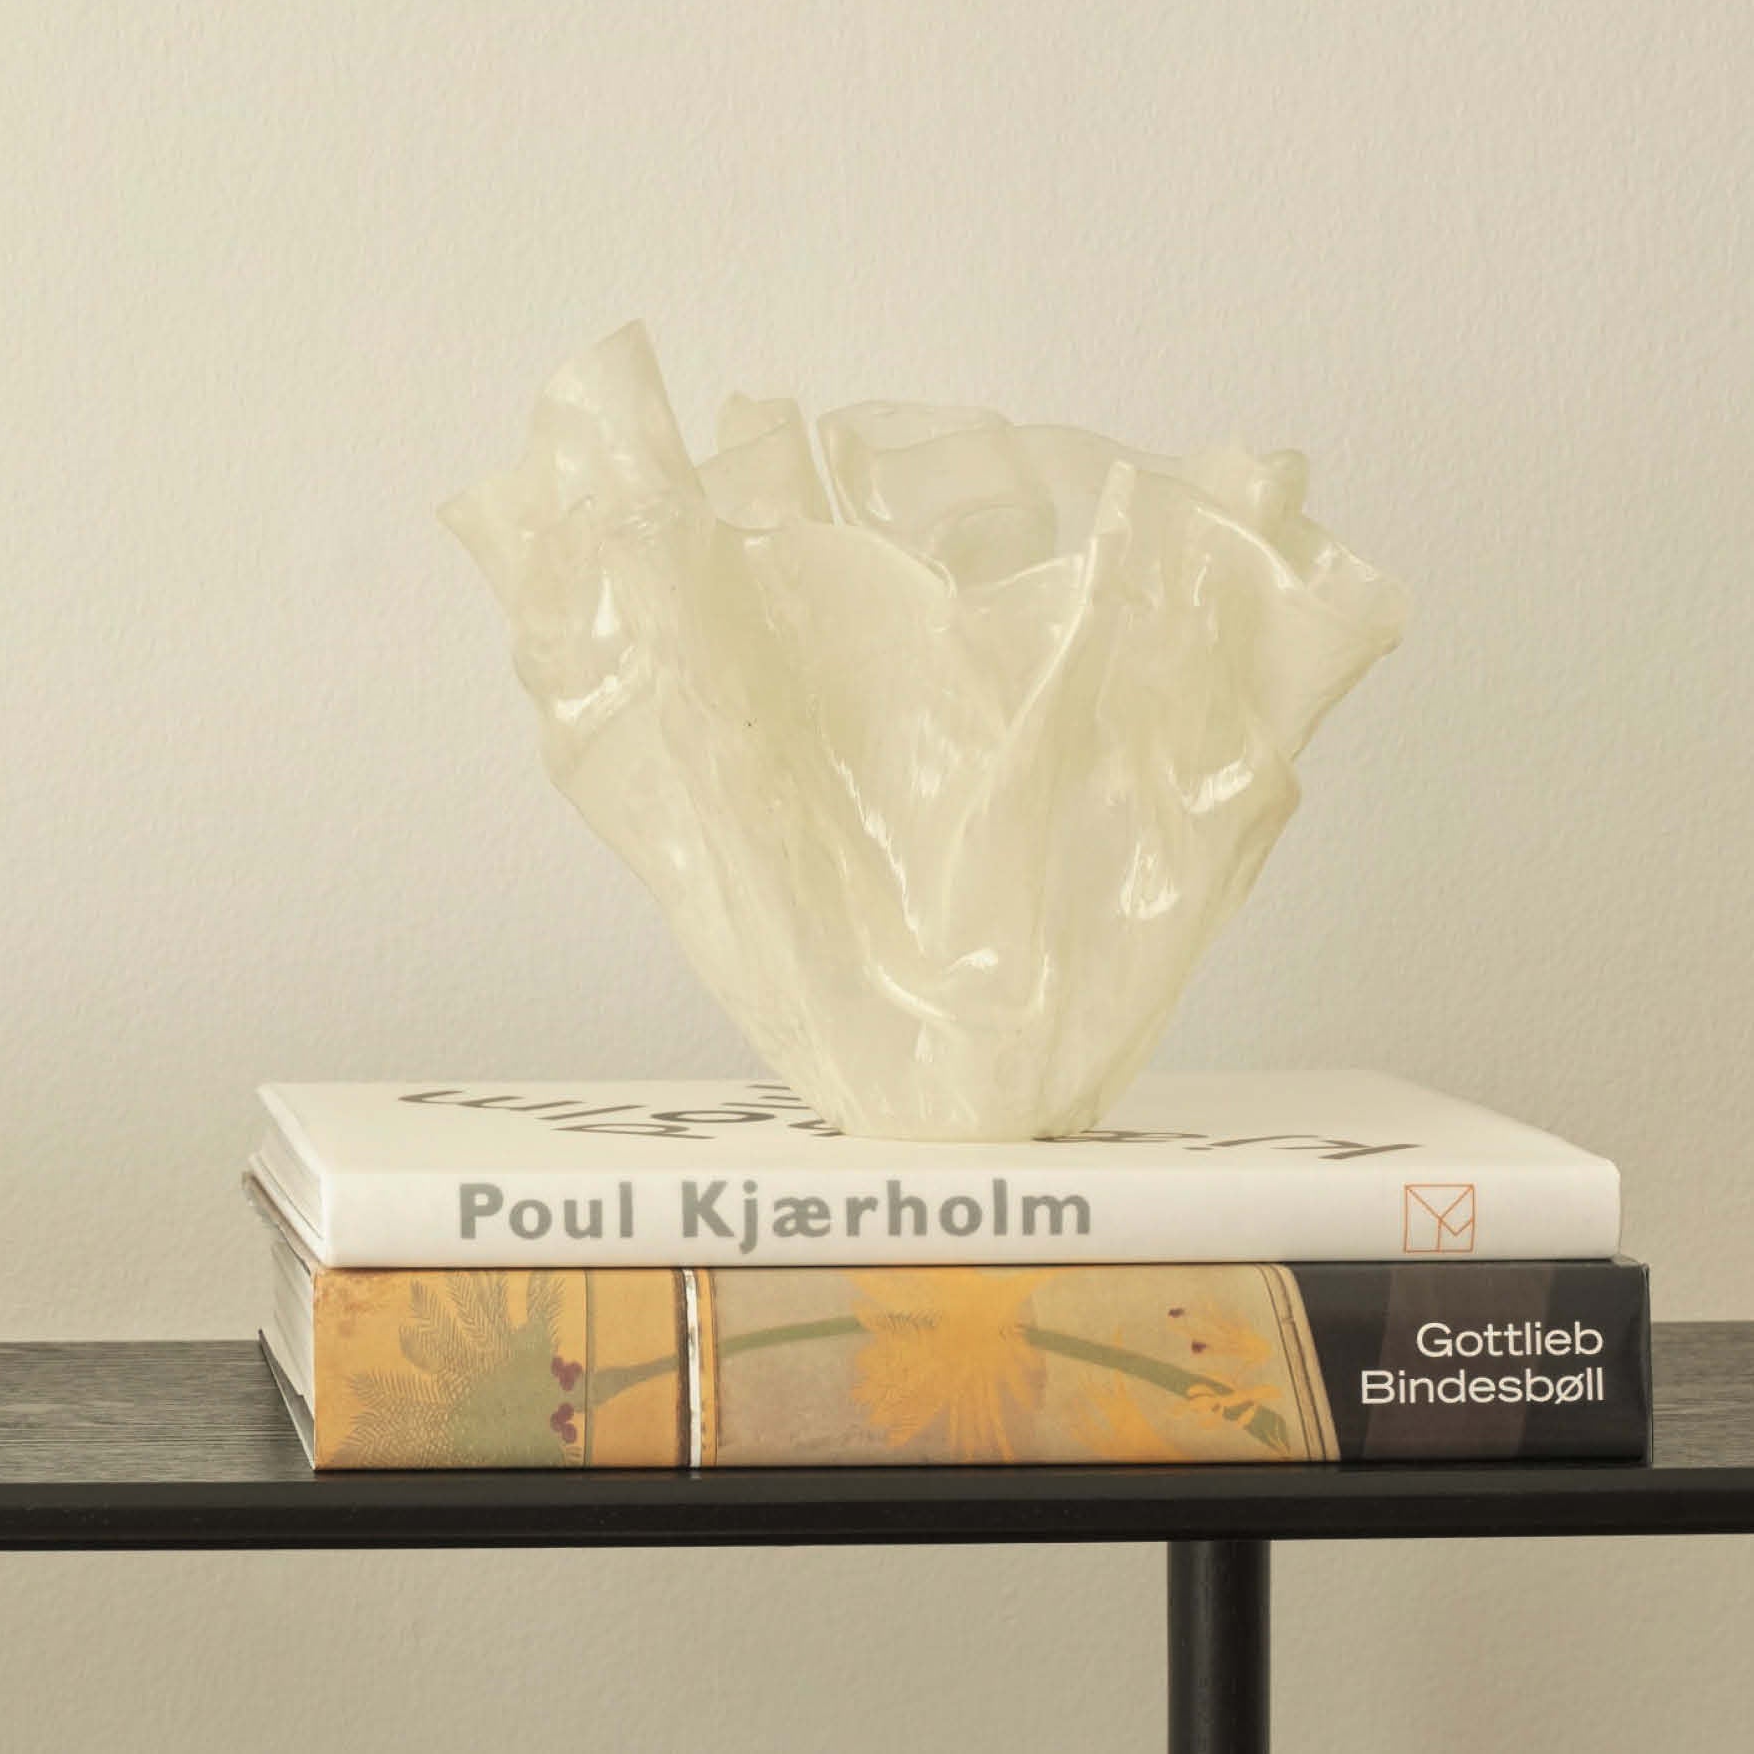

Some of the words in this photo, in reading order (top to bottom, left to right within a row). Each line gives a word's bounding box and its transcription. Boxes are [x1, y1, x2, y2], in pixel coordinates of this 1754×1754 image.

[460, 1182, 634, 1240] Poul
[682, 1179, 1090, 1256] Kjærholm
[1417, 1321, 1603, 1357] Gottlieb
[1362, 1367, 1603, 1404] Bindesbøll
